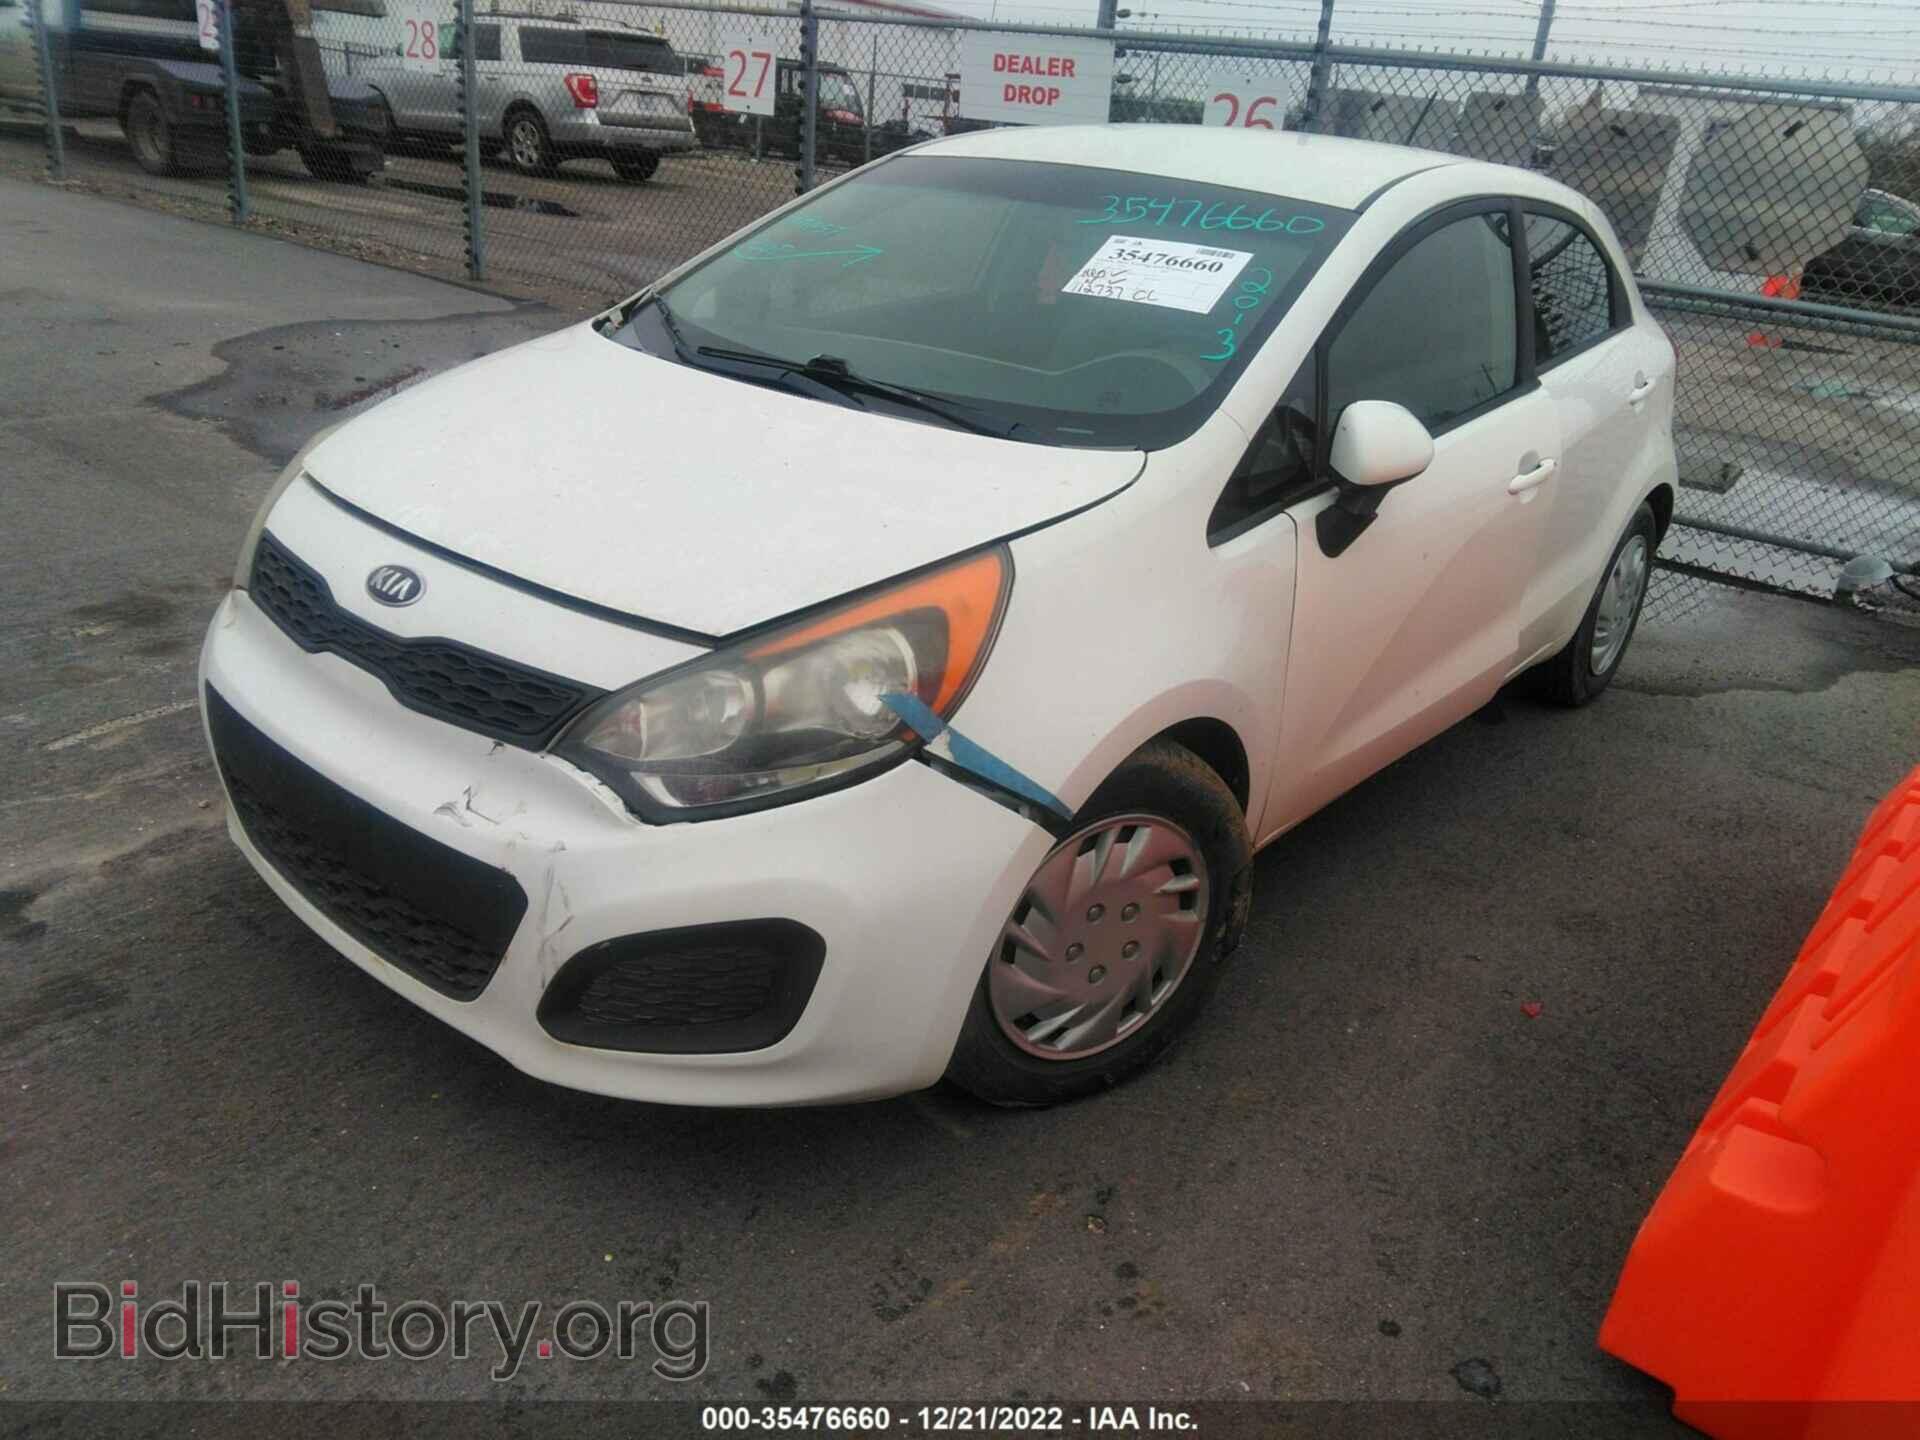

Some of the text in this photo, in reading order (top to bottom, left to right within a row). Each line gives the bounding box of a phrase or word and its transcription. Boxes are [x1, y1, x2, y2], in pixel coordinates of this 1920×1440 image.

[405, 19, 436, 60] 28
[728, 49, 771, 98] 27
[993, 53, 1076, 78] DEALER
[1003, 83, 1060, 106] DROP
[1213, 92, 1277, 130] 26
[1075, 196, 1325, 233] 35476660
[1108, 248, 1224, 273] 35476660
[369, 567, 413, 600] KIA
